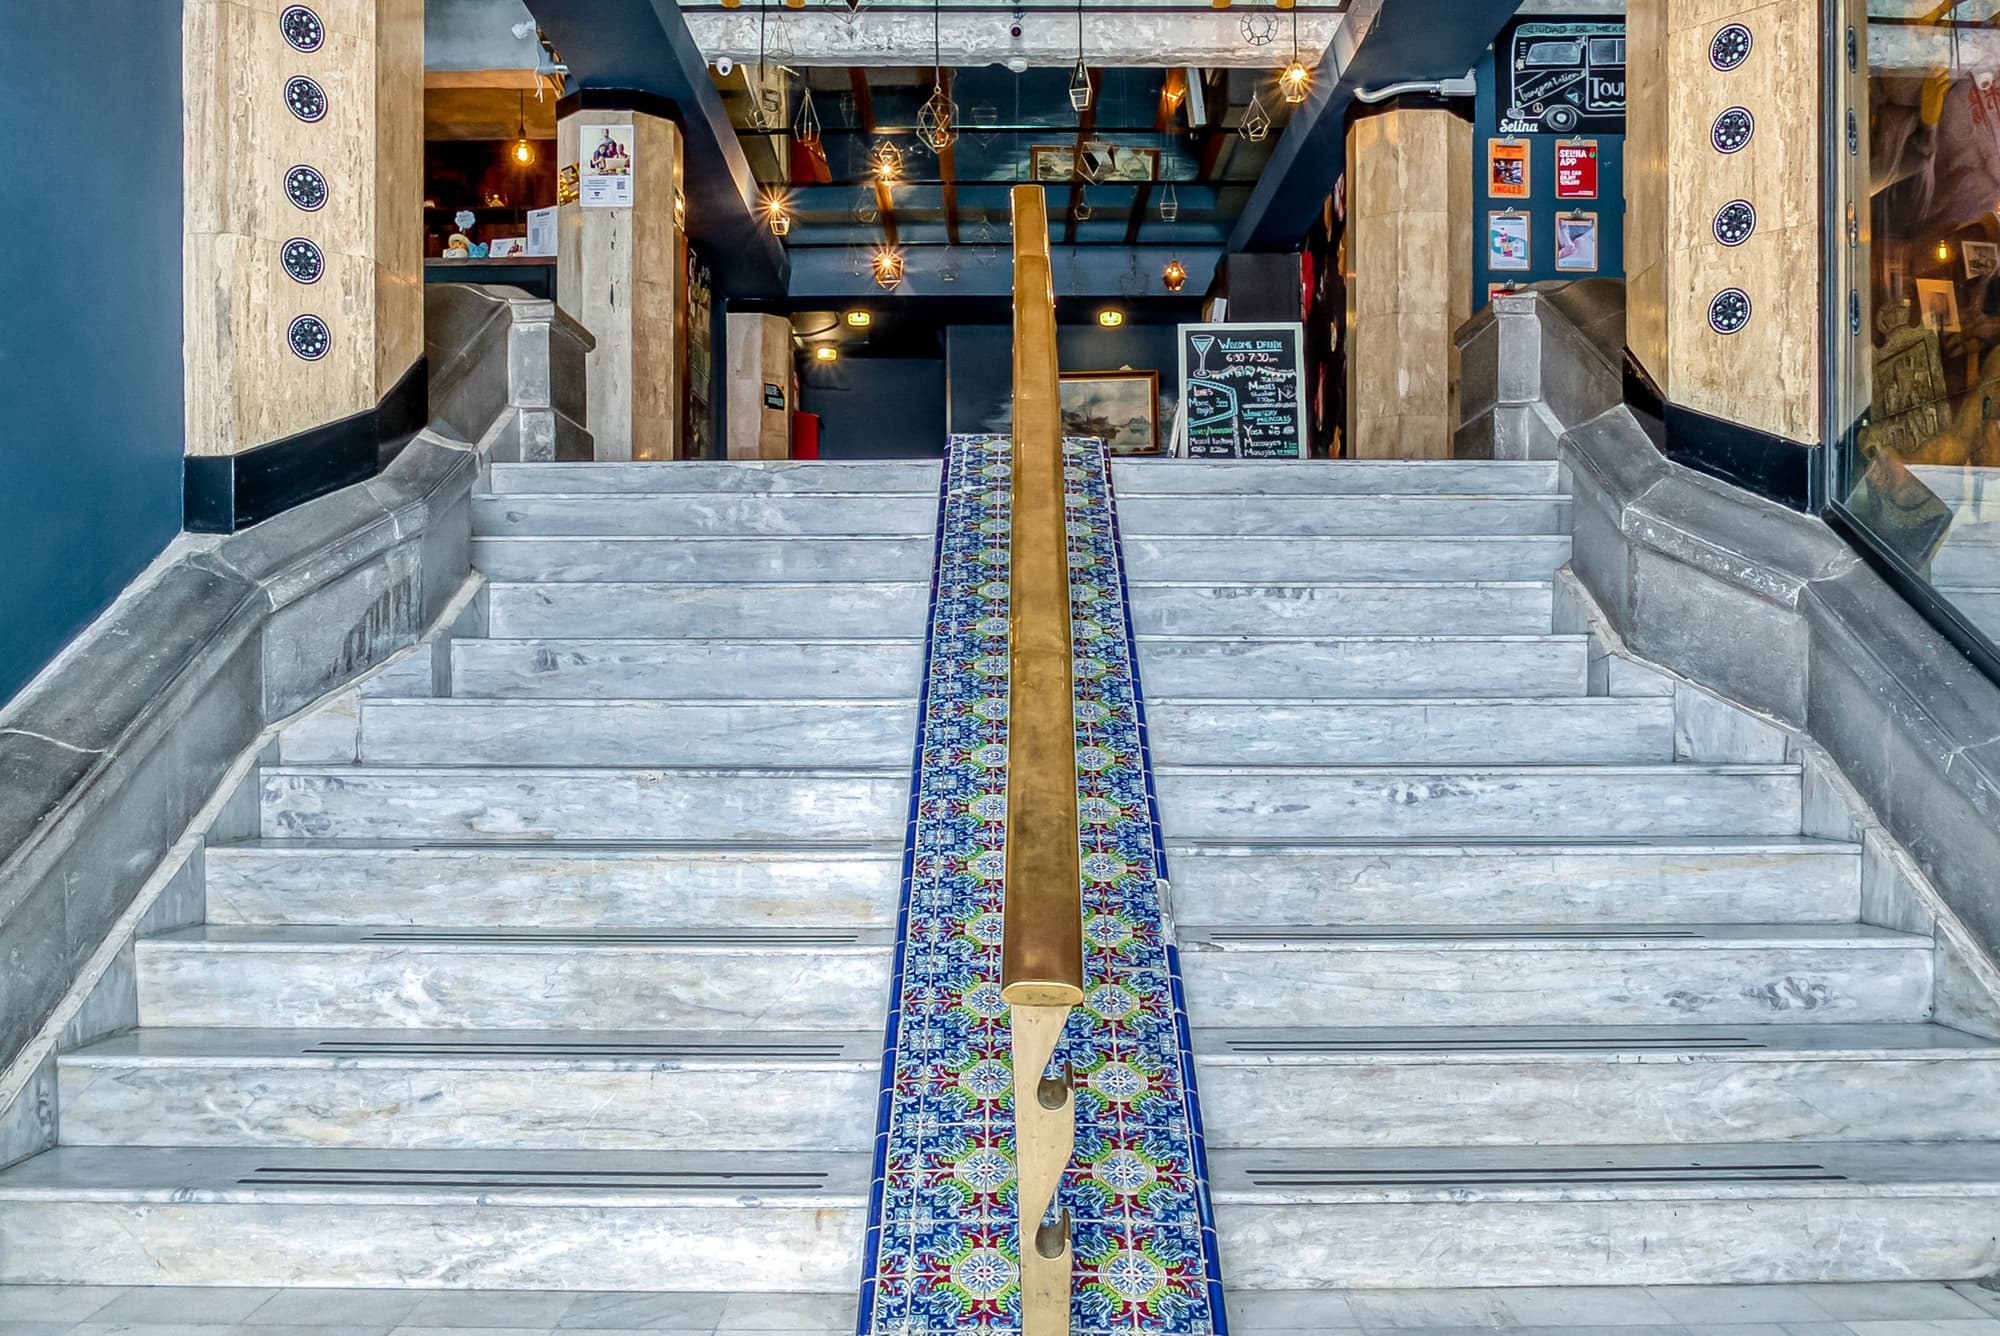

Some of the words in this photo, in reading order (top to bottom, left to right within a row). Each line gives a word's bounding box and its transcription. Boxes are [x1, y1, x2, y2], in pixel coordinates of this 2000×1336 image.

[1575, 25, 1588, 33] DE
[1499, 119, 1539, 133] Selina
[1560, 158, 1577, 166] APP
